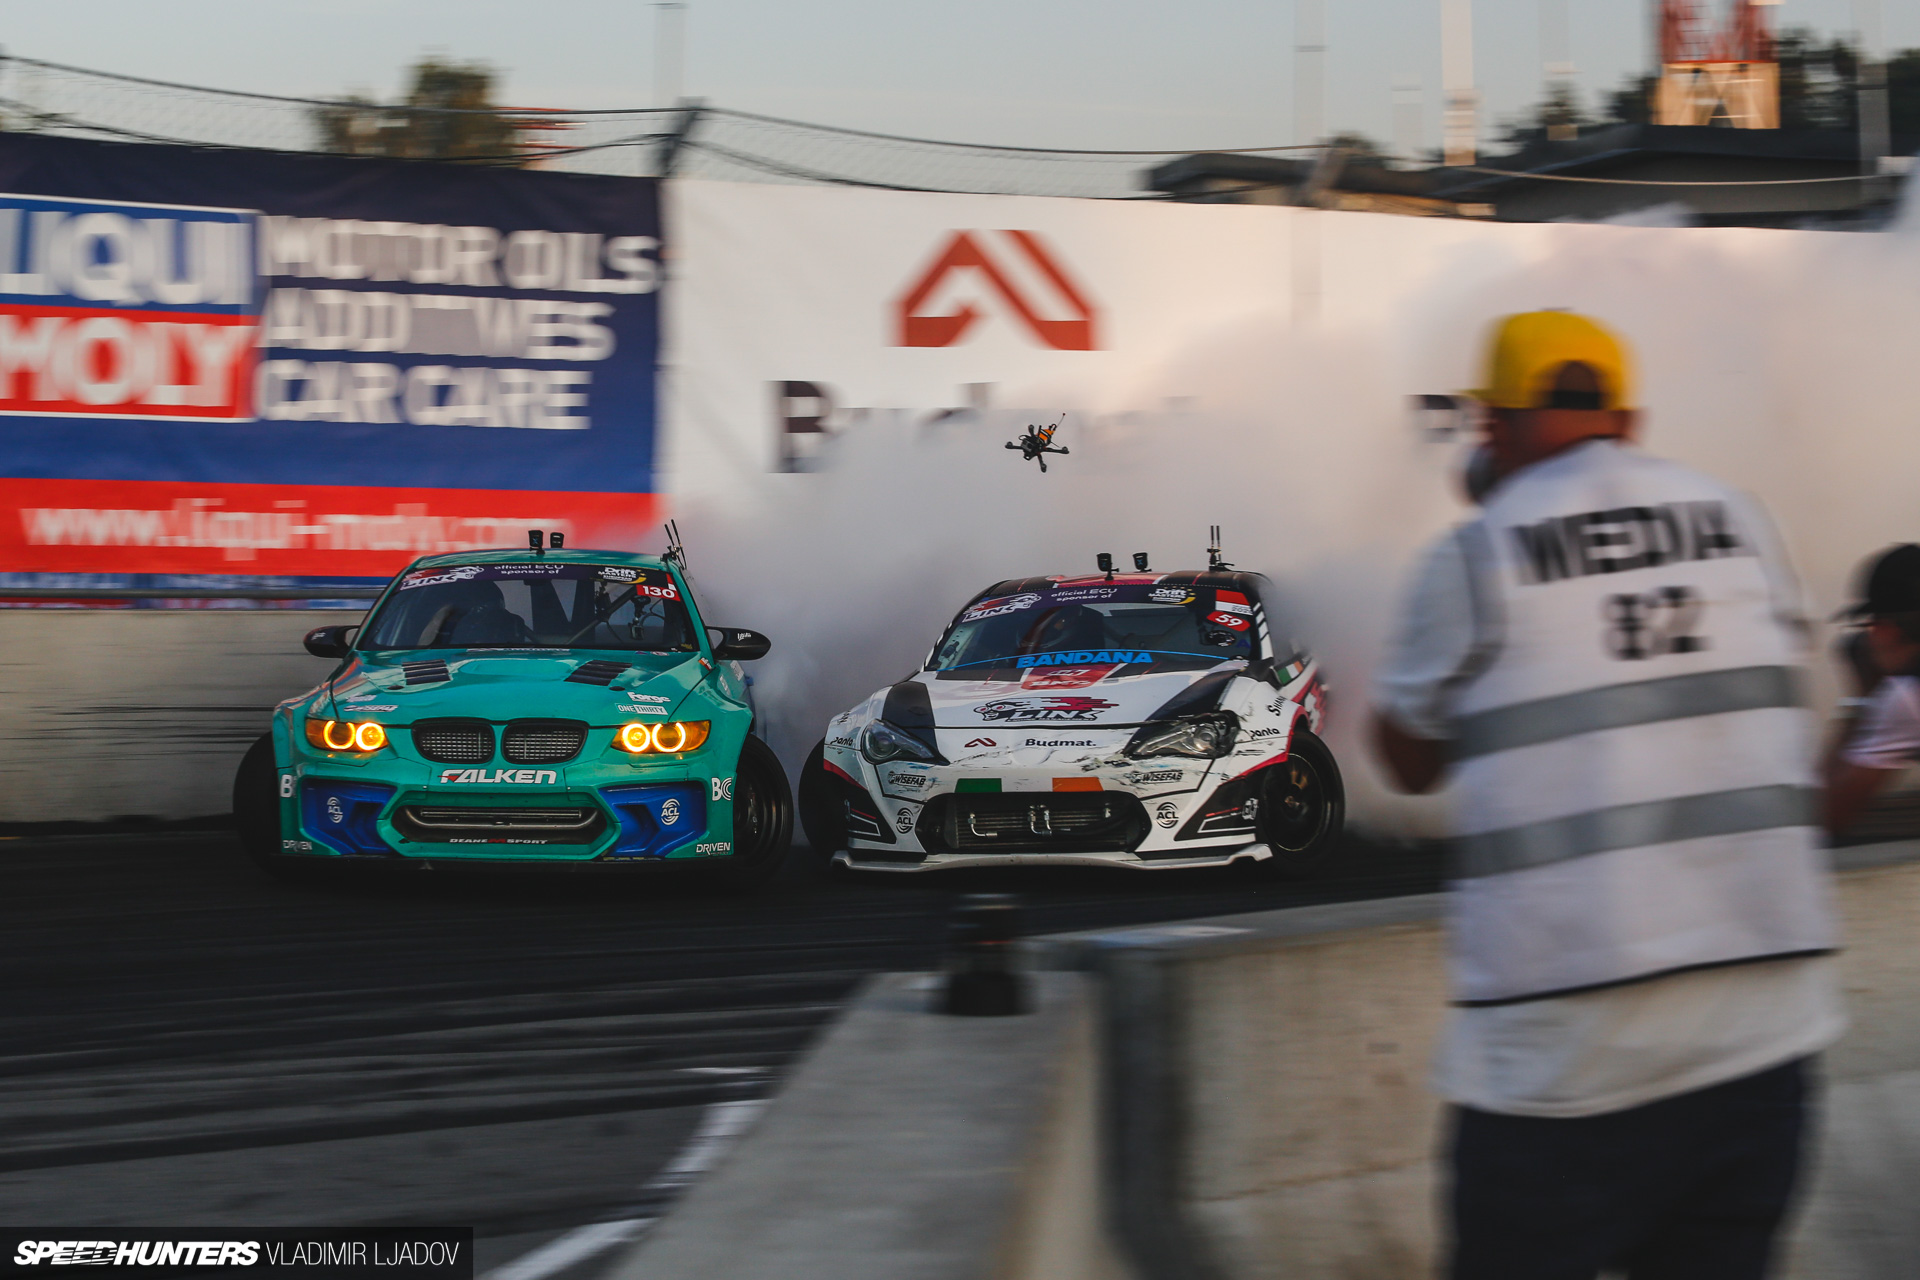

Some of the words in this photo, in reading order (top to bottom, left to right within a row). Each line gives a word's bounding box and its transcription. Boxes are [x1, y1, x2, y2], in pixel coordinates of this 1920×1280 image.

[503, 230, 664, 294] OILS
[254, 359, 403, 424] CAR
[404, 364, 594, 430] CARE
[1506, 500, 1758, 585] MEDIA
[604, 567, 636, 575] Drift
[642, 586, 675, 598] 130
[1215, 614, 1243, 626] 59
[1604, 587, 1706, 661] 82
[1016, 652, 1153, 668] BANDANA
[440, 769, 557, 784] FALKEN
[893, 775, 926, 786] WISEFAB
[711, 777, 733, 801] BC
[661, 808, 680, 817] ACL
[1156, 811, 1179, 820] ACL
[896, 816, 914, 825] ACL
[696, 842, 731, 855] DRIVEN
